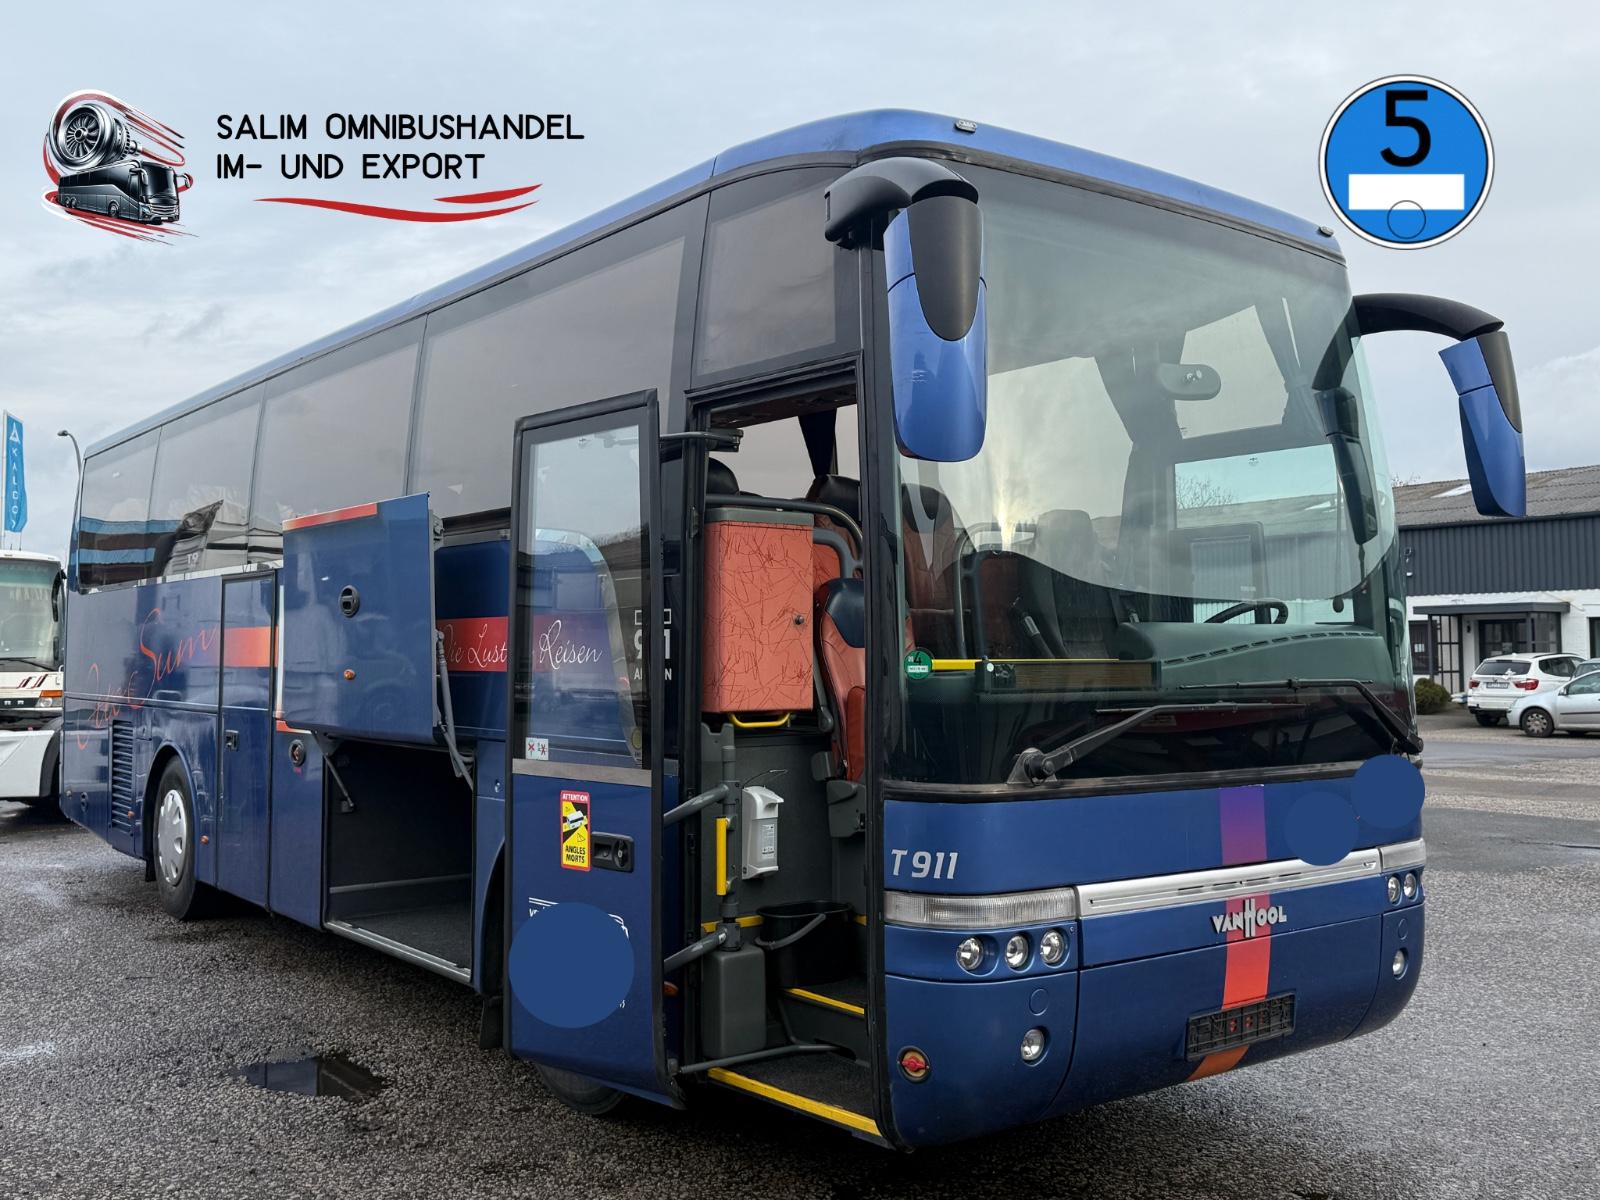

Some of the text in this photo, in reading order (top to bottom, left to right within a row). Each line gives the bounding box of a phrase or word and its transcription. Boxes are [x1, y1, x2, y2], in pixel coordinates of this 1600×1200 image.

[467, 623, 508, 668] Lust
[539, 619, 603, 670] Reisen
[562, 793, 588, 802] ATTENTION
[565, 845, 586, 855] ANGLES
[565, 853, 585, 864] MORTS
